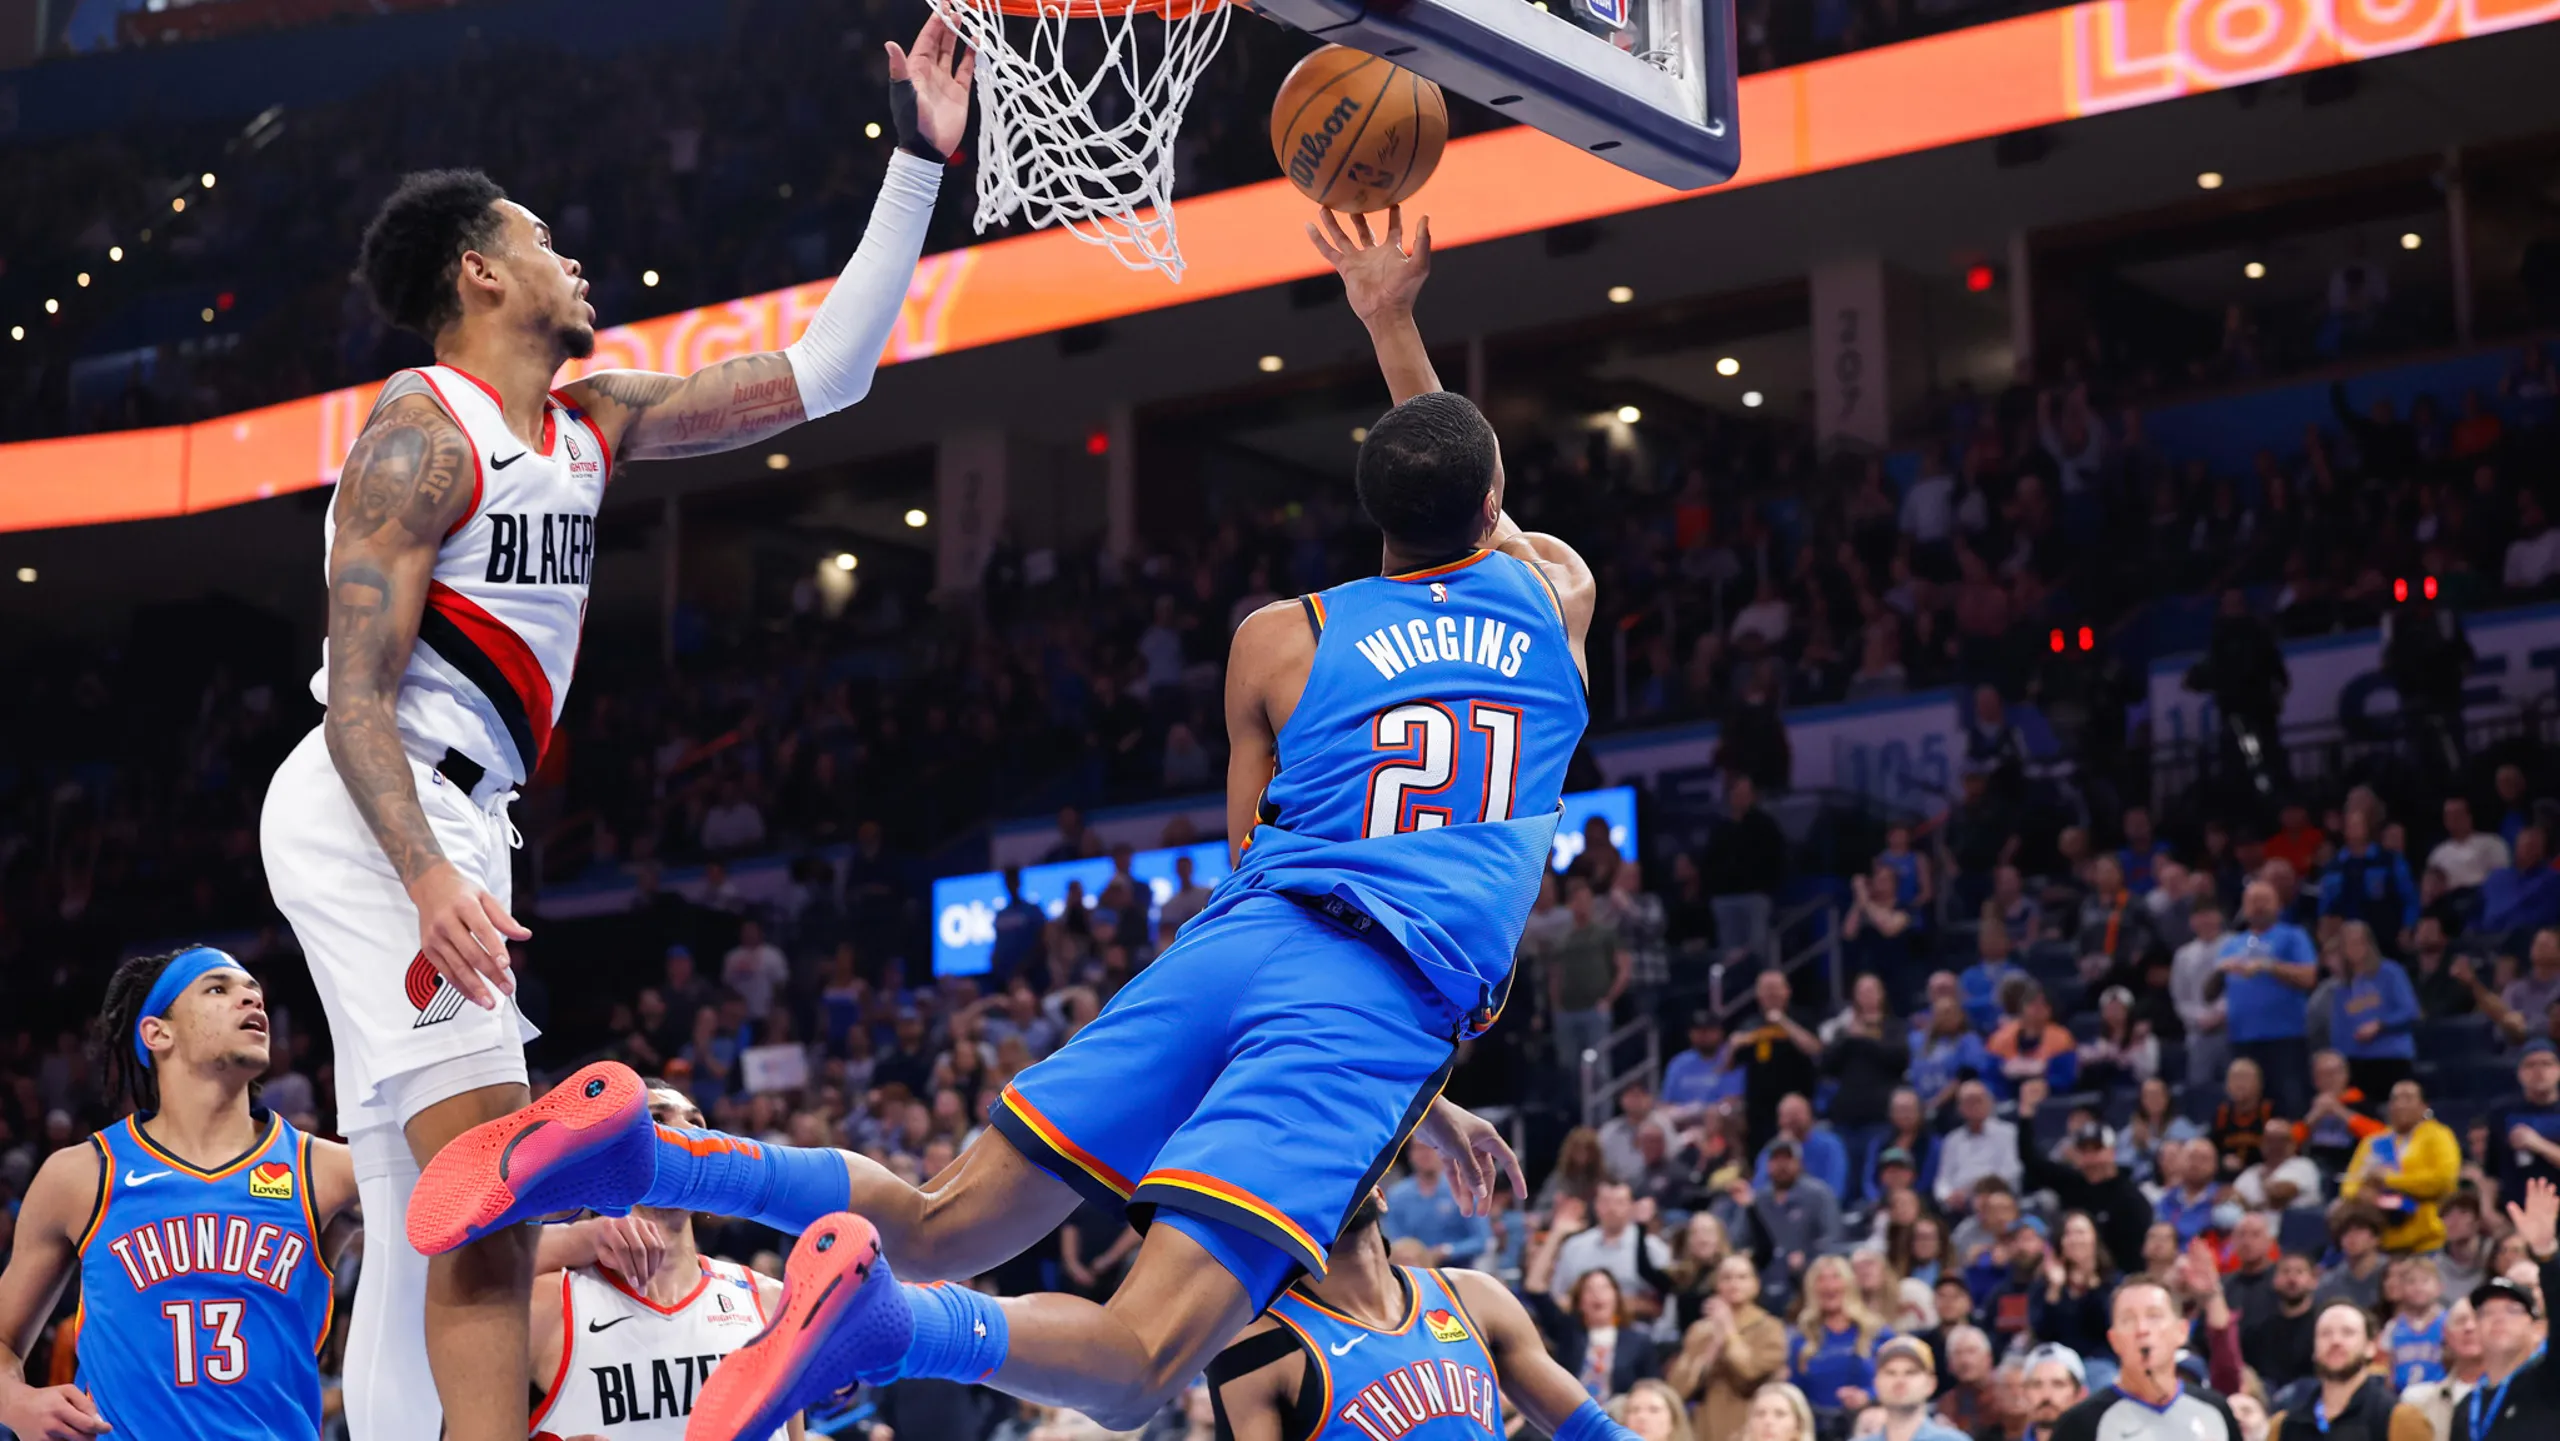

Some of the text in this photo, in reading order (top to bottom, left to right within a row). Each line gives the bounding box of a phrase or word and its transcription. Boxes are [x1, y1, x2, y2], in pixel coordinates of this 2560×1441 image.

[1290, 97, 1361, 188] Wilson
[485, 514, 594, 584] BLAZER
[1355, 616, 1532, 681] WIGGINS
[1361, 698, 1523, 839] 21
[252, 1183, 290, 1196] Love's
[108, 1212, 308, 1294] THUNDER
[161, 1298, 249, 1387] 13
[1339, 1357, 1494, 1441] THUNDER
